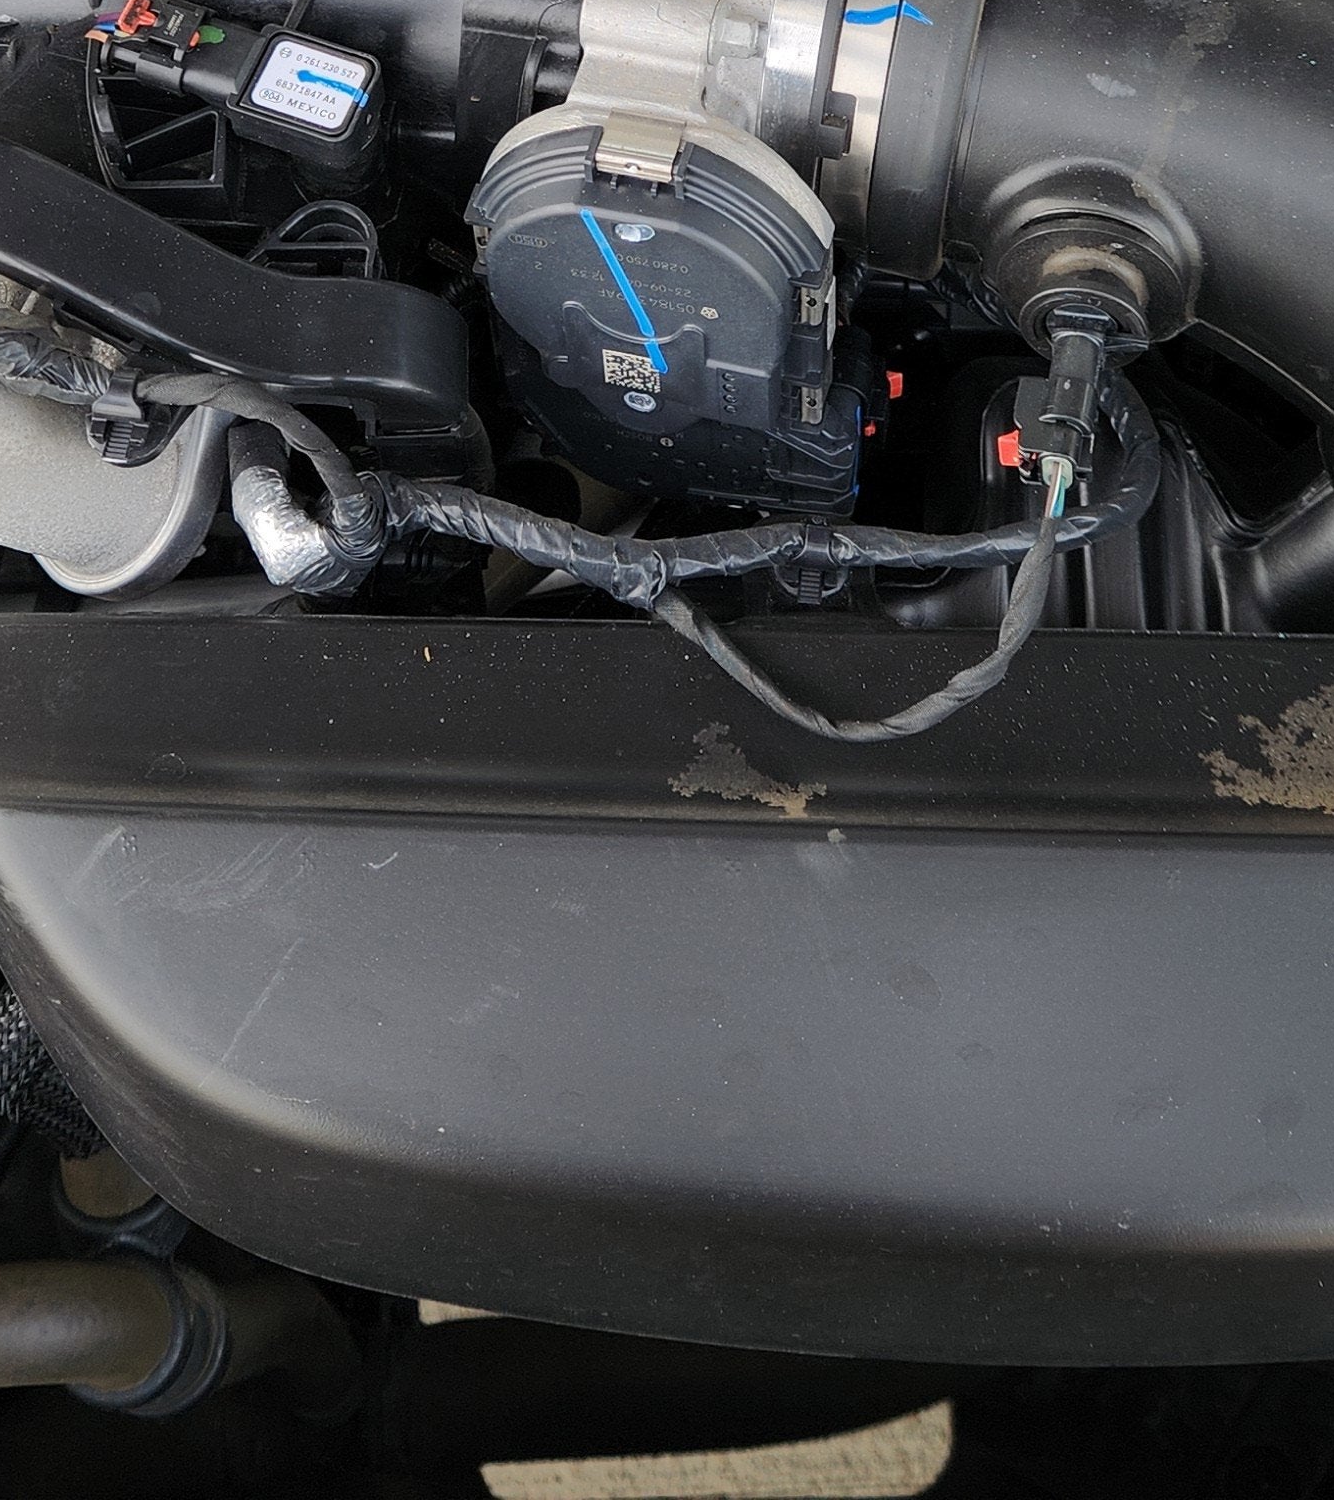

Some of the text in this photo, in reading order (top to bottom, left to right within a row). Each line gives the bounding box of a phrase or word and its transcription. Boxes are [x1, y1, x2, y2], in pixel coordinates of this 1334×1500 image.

[304, 56, 321, 68] 261
[322, 62, 340, 73] 230
[286, 98, 337, 120] MEXICO
